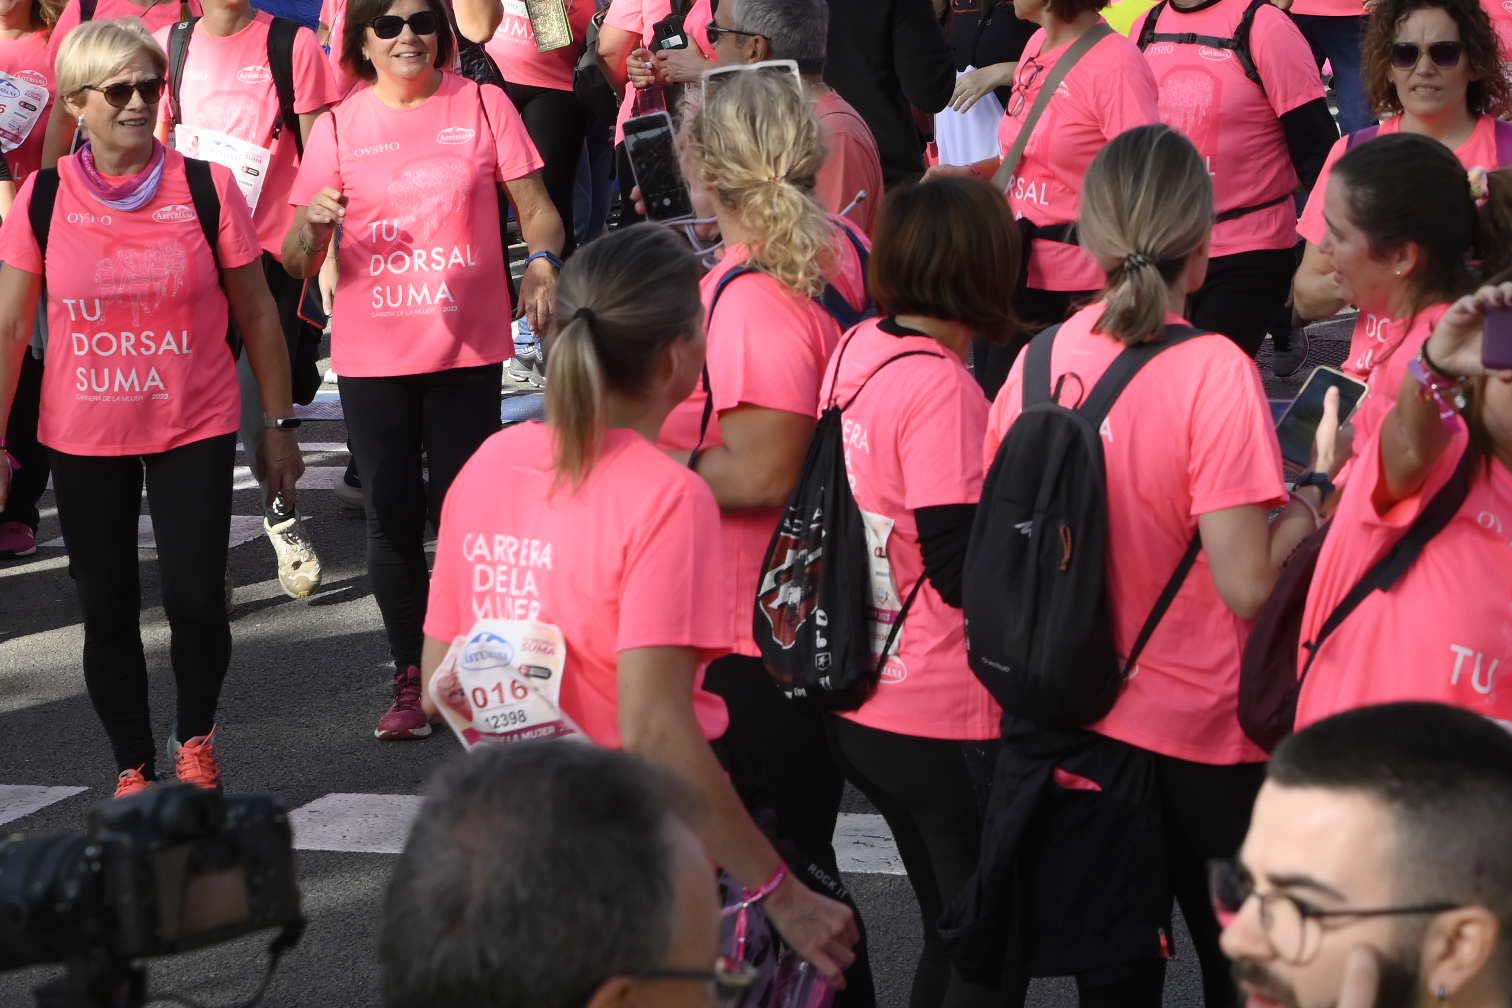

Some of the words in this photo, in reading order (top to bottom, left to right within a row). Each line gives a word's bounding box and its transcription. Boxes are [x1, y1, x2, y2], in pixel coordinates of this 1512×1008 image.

[353, 142, 401, 158] OYSHO
[1005, 178, 1049, 206] RSAL
[67, 212, 112, 226] OYSHO
[368, 219, 399, 243] TU
[369, 244, 478, 277] DORSAL
[371, 280, 454, 309] SUMA
[63, 298, 102, 322] TU
[71, 330, 193, 357] DORSAL
[76, 365, 165, 392] SUMA
[463, 533, 553, 569] CARRERA
[1450, 643, 1499, 694] TU
[471, 679, 529, 709] 016
[485, 709, 527, 729] 12398
